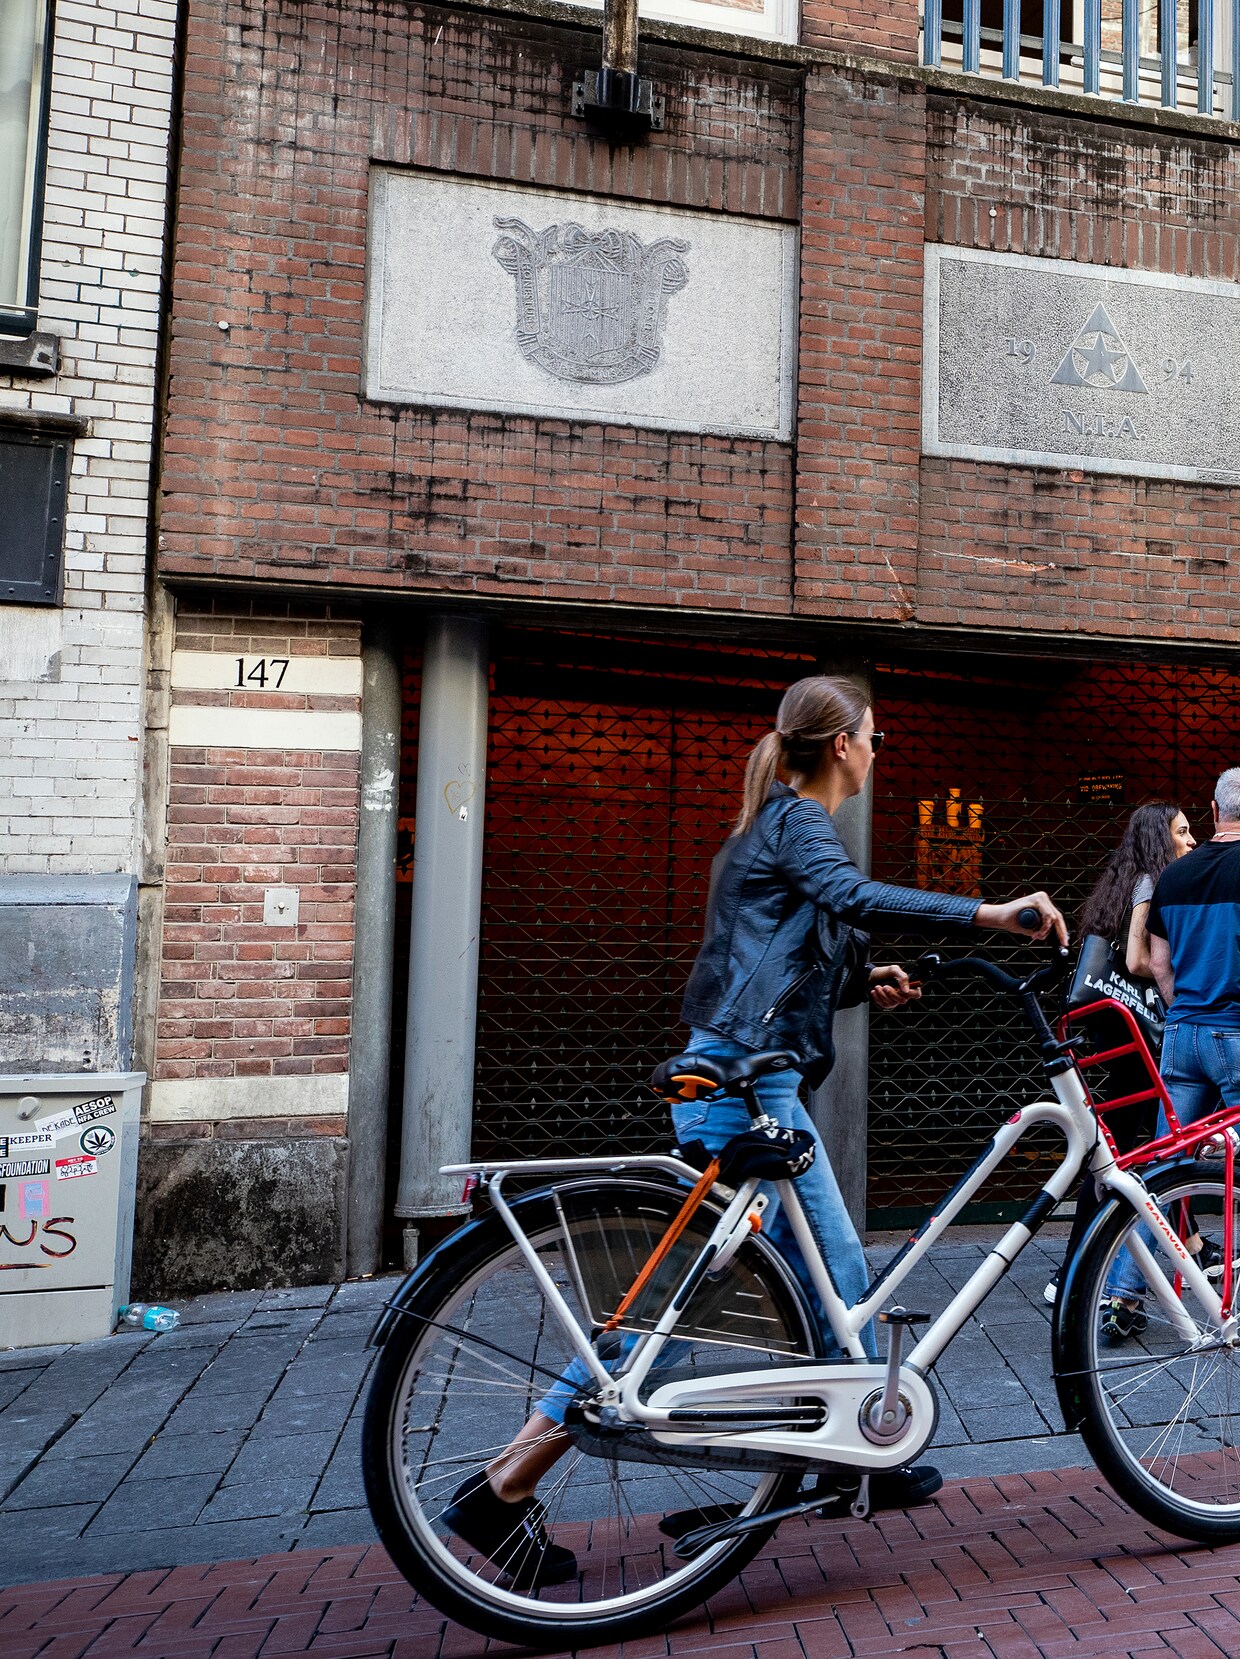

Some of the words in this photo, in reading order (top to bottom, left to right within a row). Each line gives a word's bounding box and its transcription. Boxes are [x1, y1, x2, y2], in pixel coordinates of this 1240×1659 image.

[1005, 337, 1037, 365] 19
[1162, 357, 1194, 384] 94
[1062, 410, 1146, 441] N.I.A.
[234, 658, 290, 688] 147
[1084, 973, 1159, 1024] LAGERFELD
[1109, 970, 1141, 1000] KARL
[75, 1096, 112, 1116] AESOP
[77, 1114, 93, 1124] NFA
[93, 1105, 115, 1118] CREW
[10, 1134, 52, 1145] KEEPER
[1145, 1202, 1187, 1260] BATAVUS
